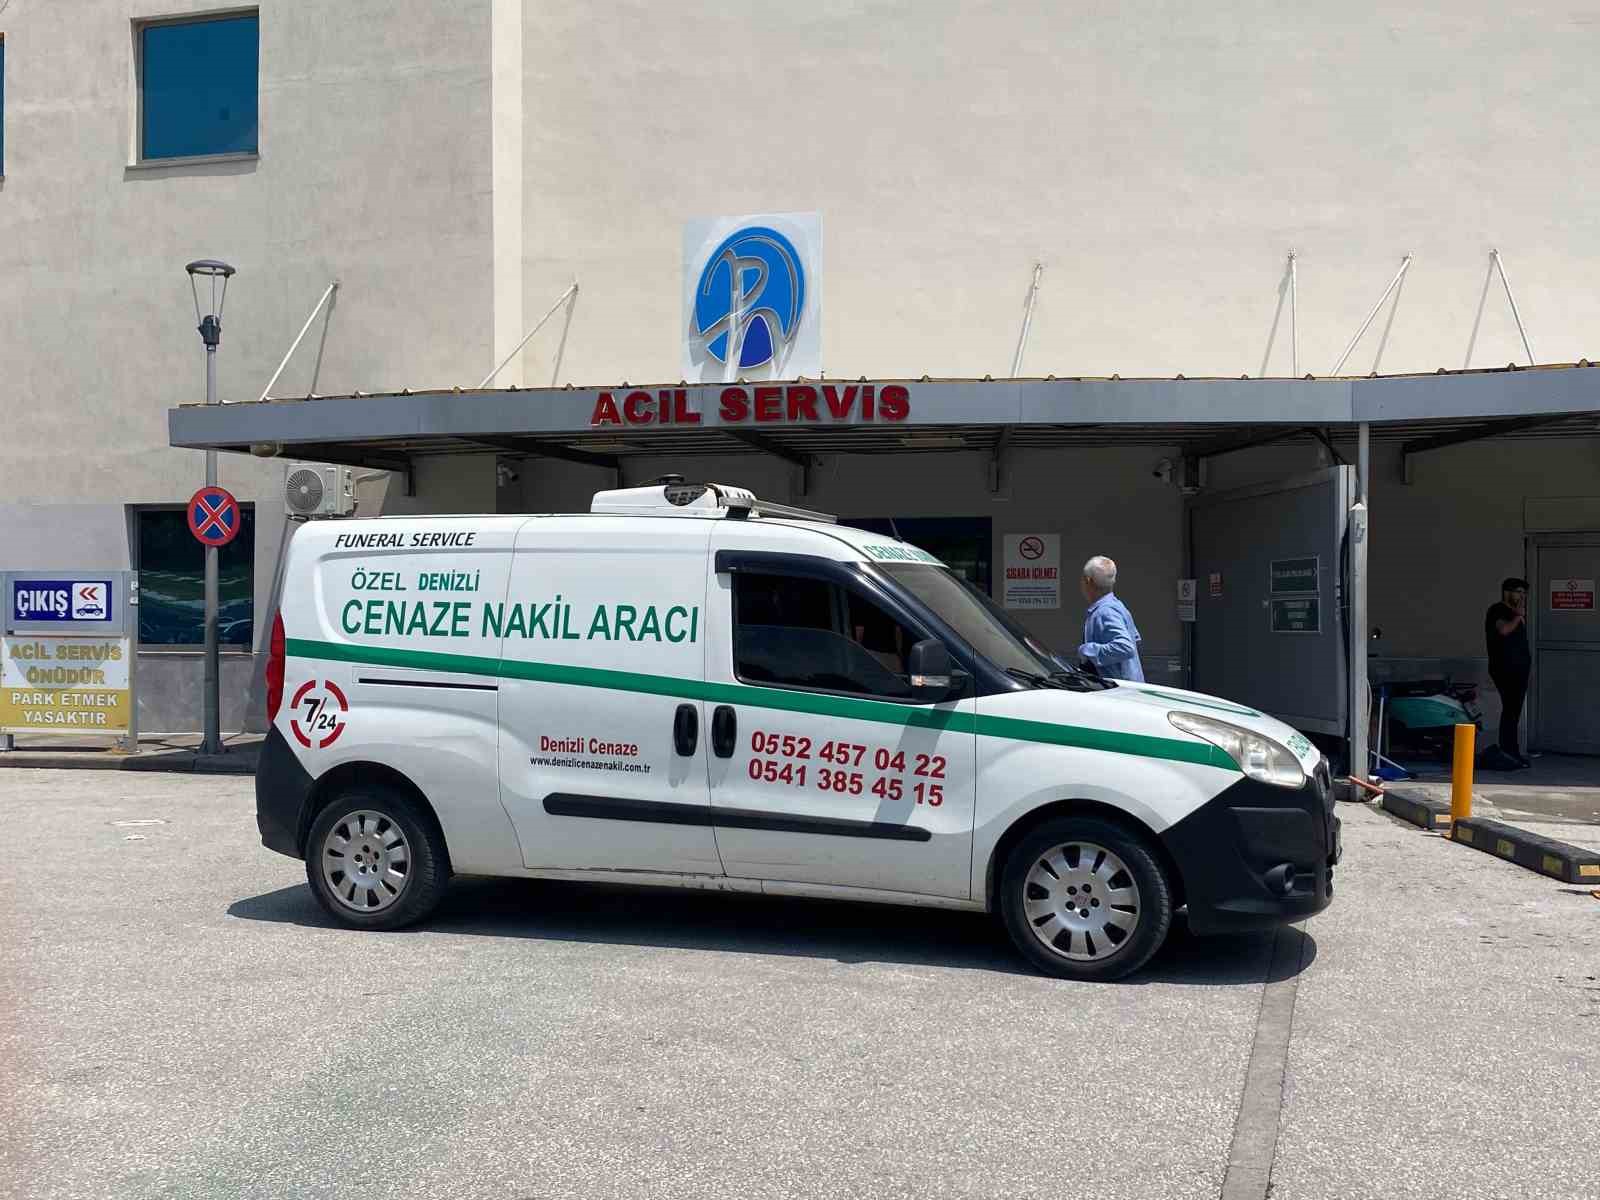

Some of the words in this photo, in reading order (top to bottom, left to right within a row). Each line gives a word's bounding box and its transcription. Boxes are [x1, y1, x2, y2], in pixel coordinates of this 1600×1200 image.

[335, 533, 405, 548] FUNERAL
[410, 532, 476, 547] SERVICE
[351, 567, 407, 591] ÖZEL
[418, 569, 480, 592] DENİZLİ
[17, 590, 68, 617] ÇIKIŞ
[342, 599, 472, 637] CENAZE
[481, 594, 580, 640] NAKİL
[588, 605, 699, 643] ARACI
[55, 642, 122, 661] SERVİS
[26, 664, 105, 685] ÖNÜDÜR
[12, 692, 55, 706] PARK
[61, 692, 118, 707] ETMEK
[24, 710, 107, 725] YASAKTIR
[540, 735, 585, 753] Denizli
[588, 738, 638, 756] Cenaze
[751, 731, 812, 760] 0552
[819, 740, 867, 767] 457
[874, 748, 906, 773] 04
[913, 753, 946, 779] 22
[530, 756, 651, 773] www.denizlicenazenakil.com.tr
[749, 758, 807, 787] 0541
[817, 768, 864, 795] 385
[871, 777, 904, 801] 45
[913, 782, 944, 807] 15
